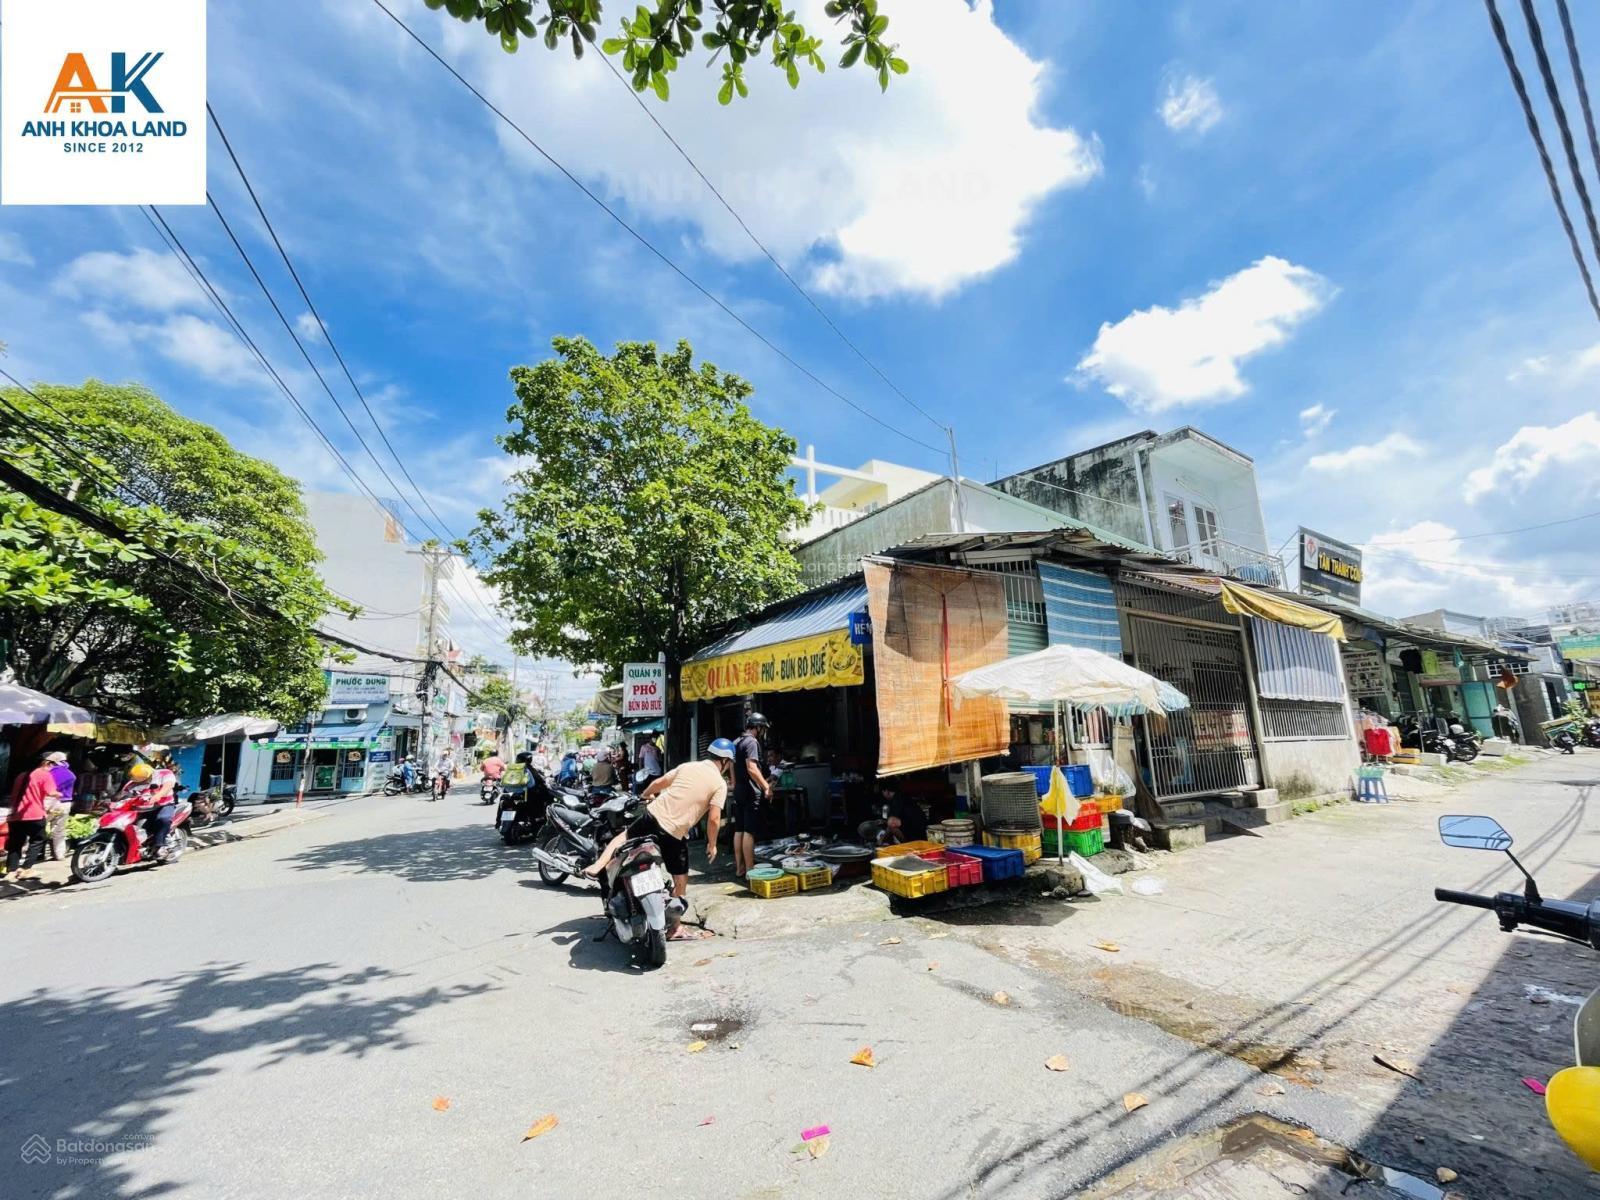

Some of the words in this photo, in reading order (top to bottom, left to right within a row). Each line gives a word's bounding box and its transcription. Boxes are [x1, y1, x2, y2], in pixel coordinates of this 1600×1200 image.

[628, 668, 651, 679] QUÁN
[652, 669, 662, 679] 98
[707, 661, 741, 693] QUÁN
[744, 660, 760, 686] 98
[761, 654, 776, 682] PHỞ
[780, 651, 797, 680] BÚN
[798, 649, 809, 677] BÒ
[810, 643, 828, 675] HUẾ
[632, 681, 657, 695] PHỞ
[628, 698, 640, 711] BÚN
[641, 697, 650, 711] BÒ
[650, 695, 663, 711] HUẾ
